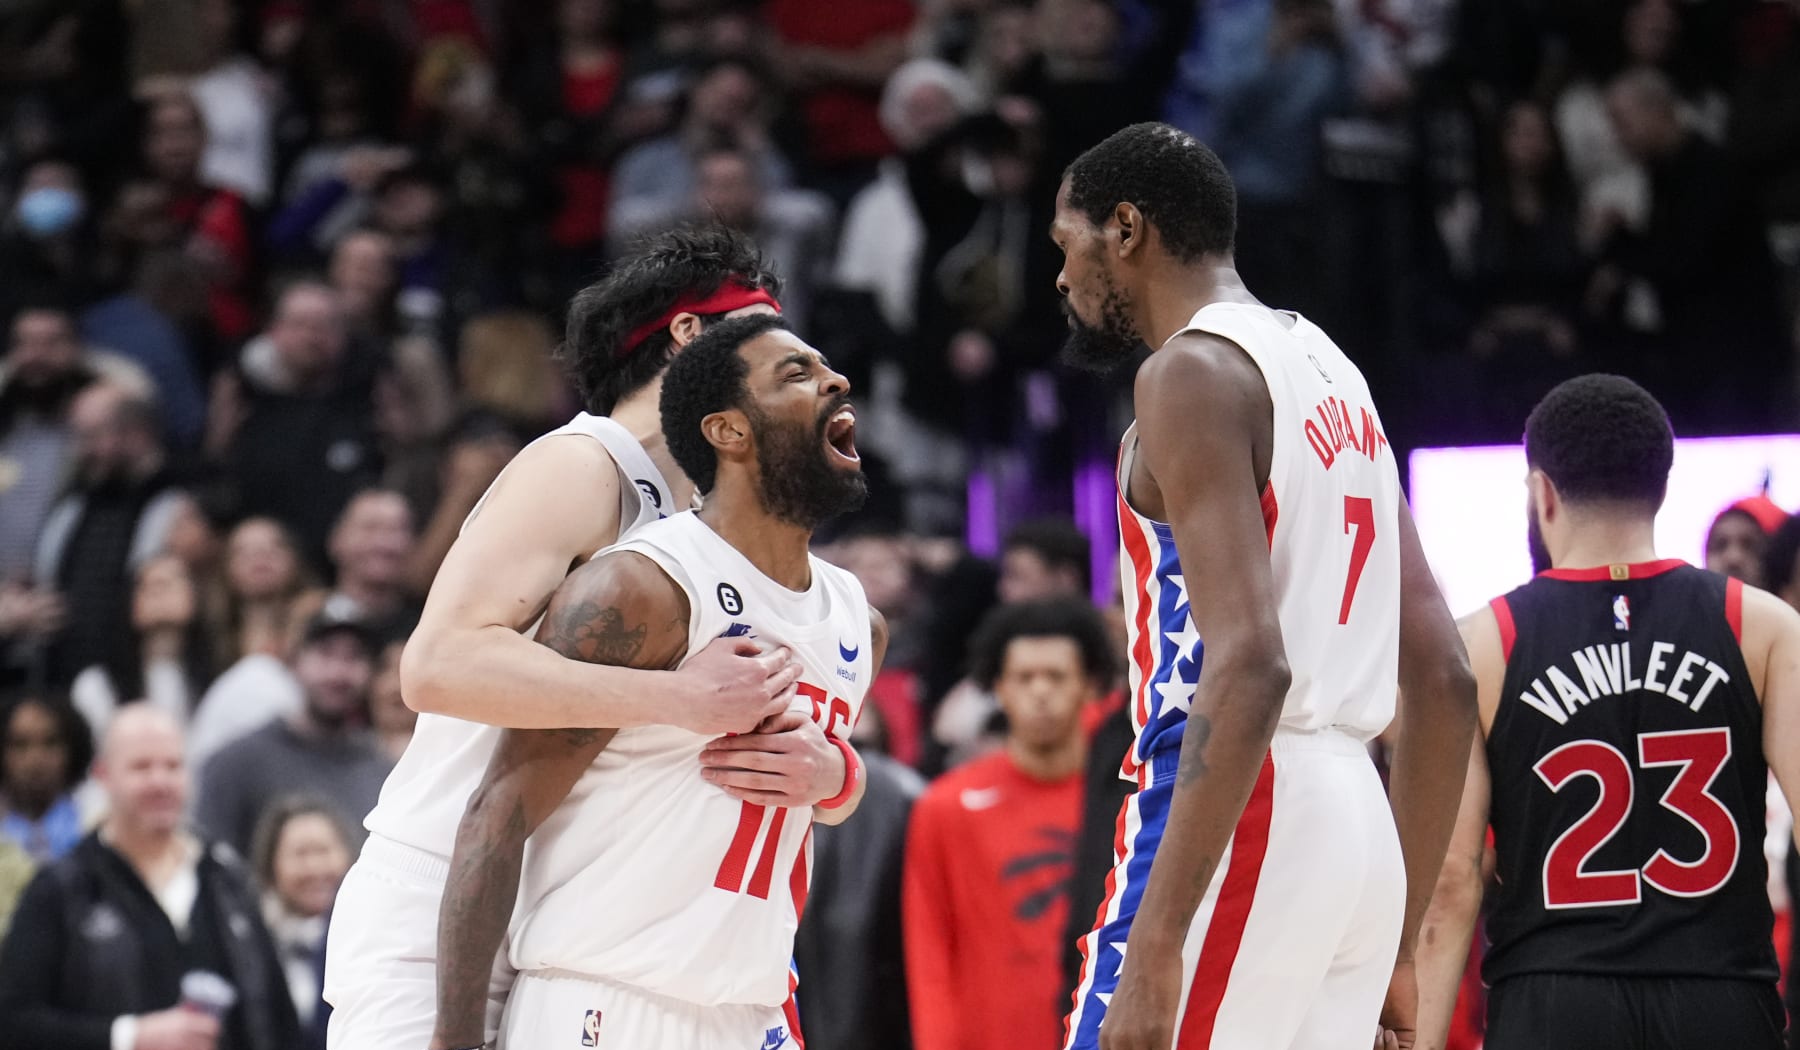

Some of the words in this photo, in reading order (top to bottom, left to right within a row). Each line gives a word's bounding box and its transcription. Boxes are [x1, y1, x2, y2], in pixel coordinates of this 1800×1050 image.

[719, 586, 740, 612] 6
[1338, 495, 1376, 625] 7
[1519, 641, 1730, 725] VANVLEET
[713, 799, 788, 900] 11
[1532, 726, 1740, 909] 23
